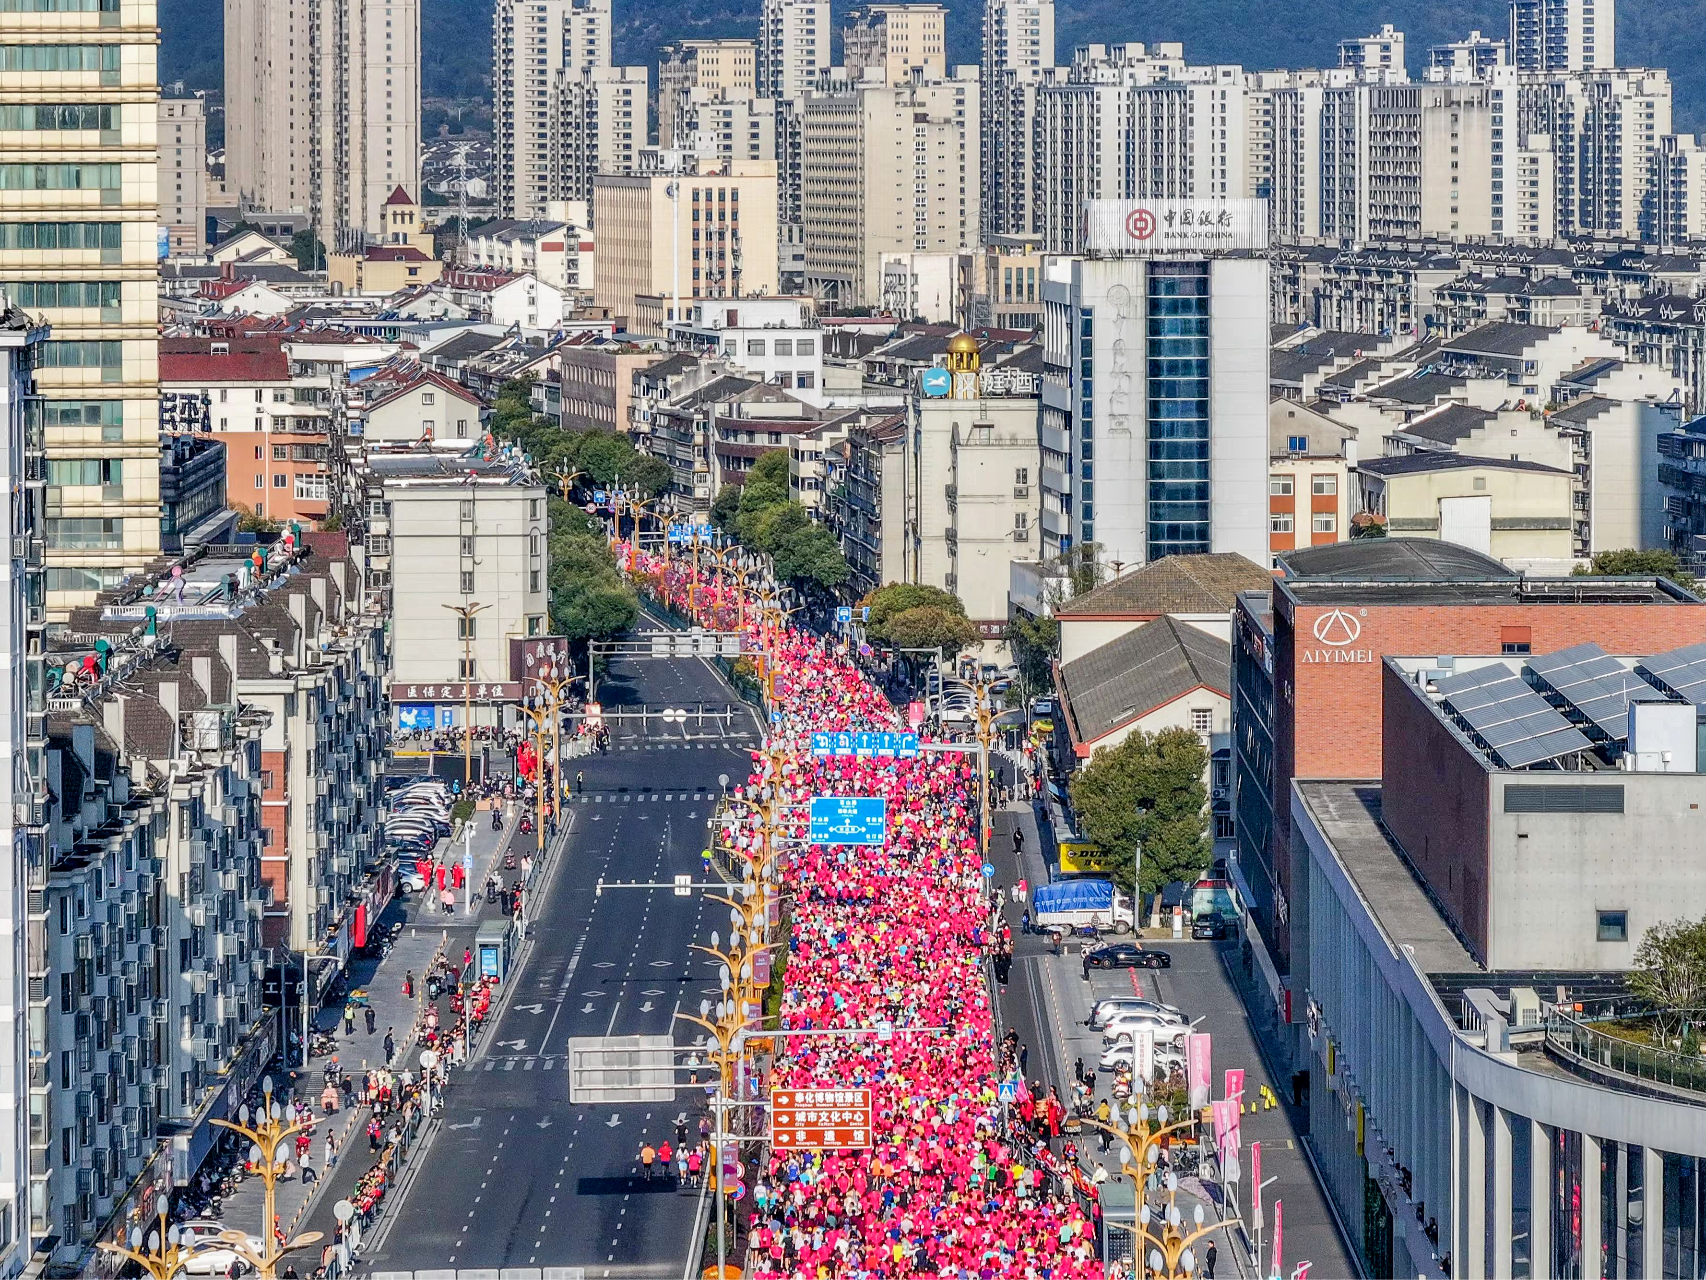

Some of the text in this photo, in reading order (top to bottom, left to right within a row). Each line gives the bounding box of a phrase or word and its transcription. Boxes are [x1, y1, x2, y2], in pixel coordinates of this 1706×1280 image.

[1163, 208, 1233, 228] 中国银行
[1164, 231, 1234, 239] BANK OF CHINA
[1302, 649, 1373, 663] AIYIMEI
[407, 684, 504, 698] 医保定点单位
[794, 1091, 864, 1103] 奉化博物馆景区
[795, 1111, 864, 1122] 城市文化中心
